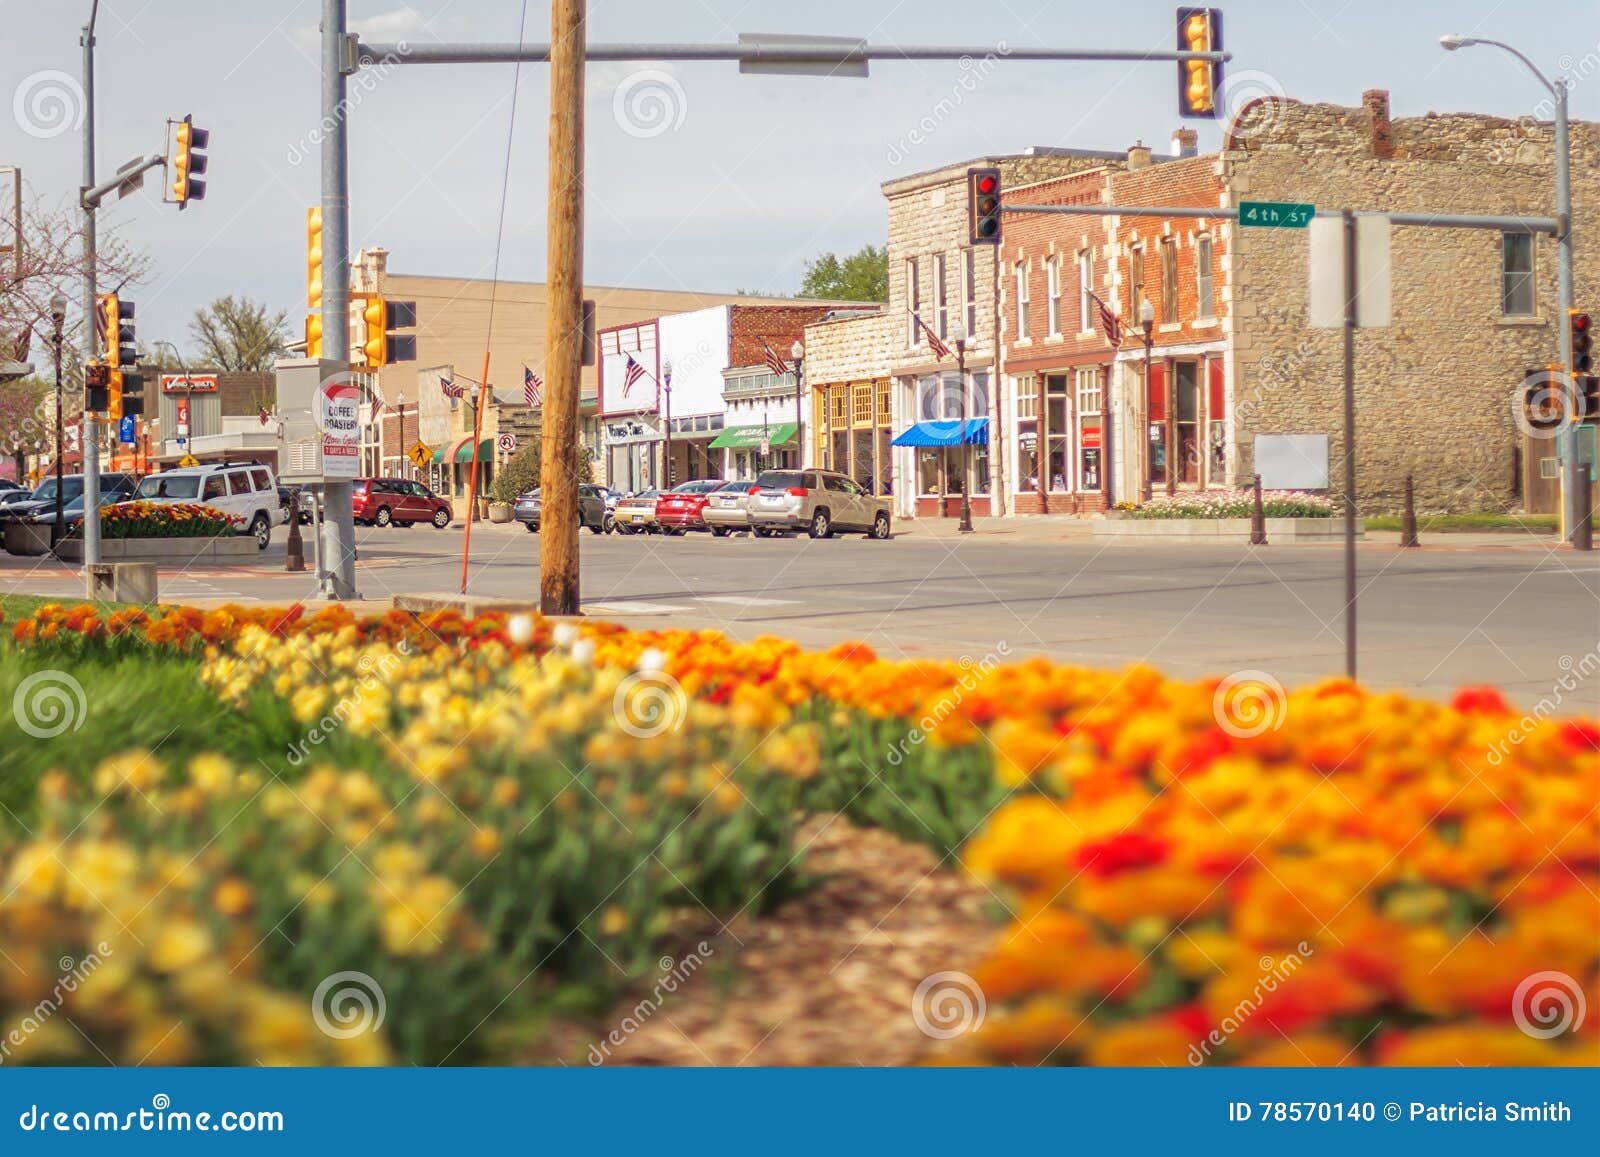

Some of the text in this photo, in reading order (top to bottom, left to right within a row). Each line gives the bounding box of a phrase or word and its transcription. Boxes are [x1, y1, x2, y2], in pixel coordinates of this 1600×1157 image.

[1247, 208, 1308, 222] 4th ST
[328, 406, 355, 417] COFFEE
[324, 418, 358, 430] ROASTERY
